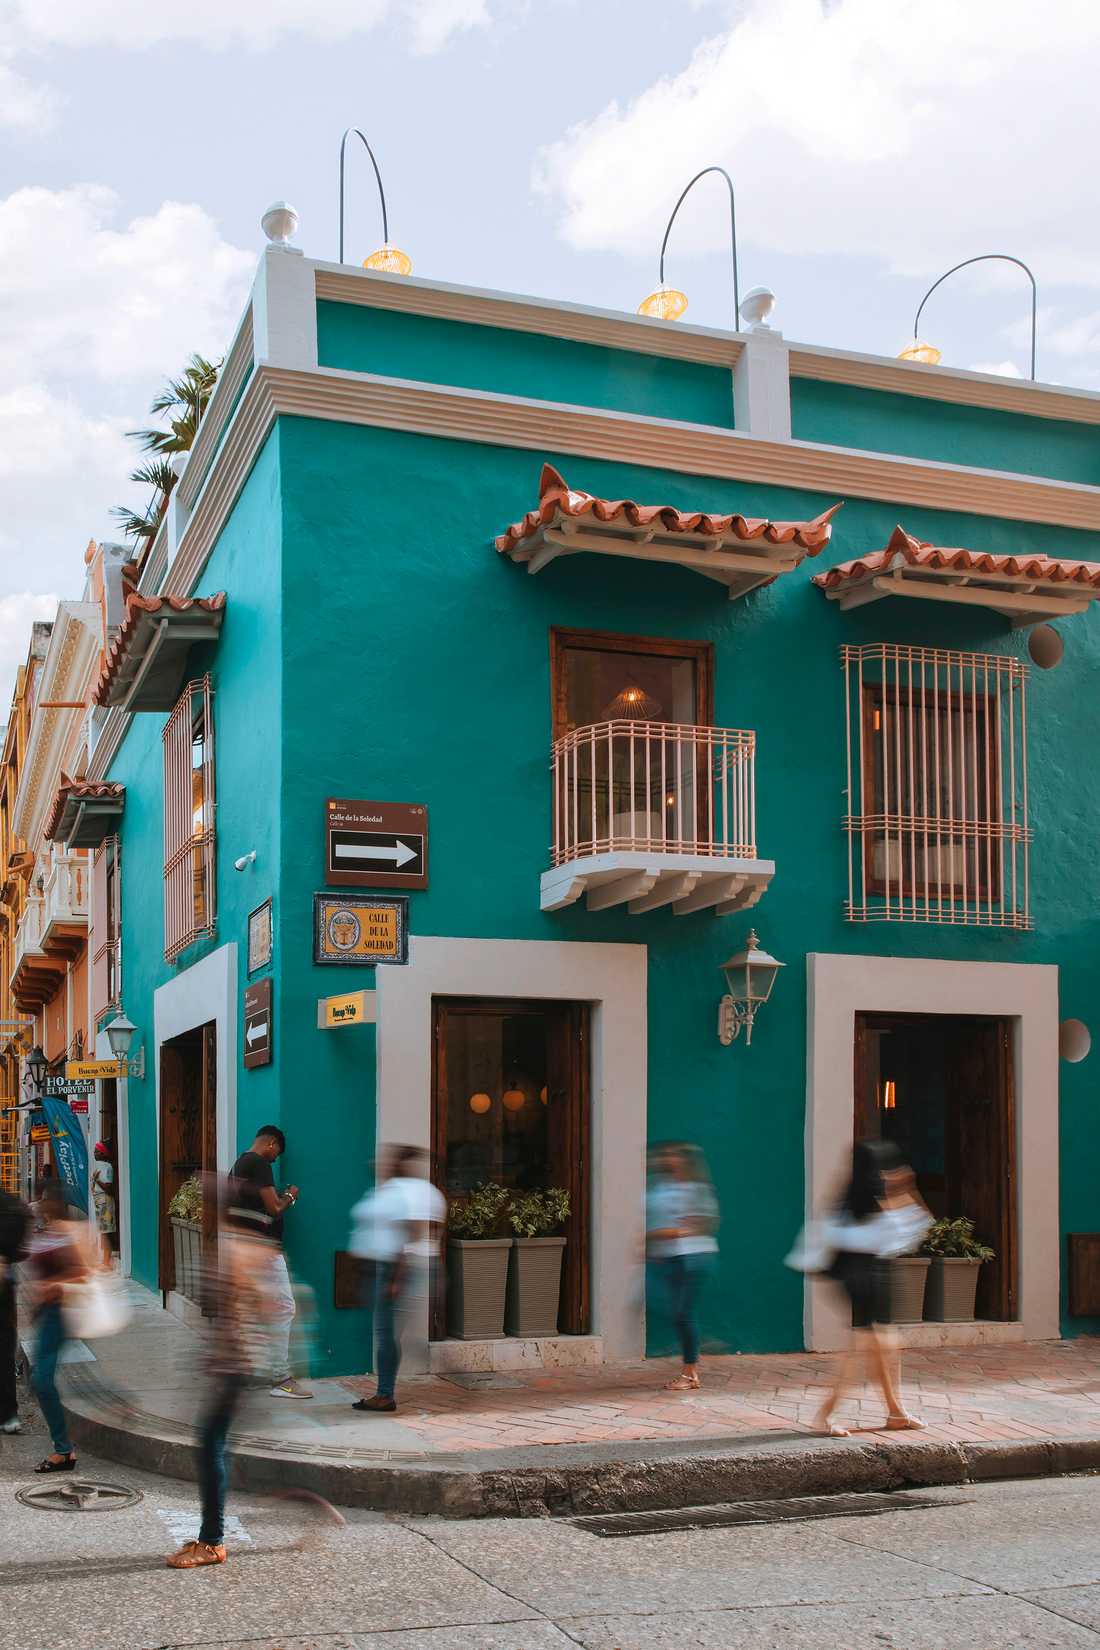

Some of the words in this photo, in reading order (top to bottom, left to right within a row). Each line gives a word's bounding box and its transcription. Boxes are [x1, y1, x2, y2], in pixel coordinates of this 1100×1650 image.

[368, 913, 389, 923] CALLE
[370, 926, 379, 936] DE
[380, 927, 389, 937] LA
[363, 940, 394, 950] SOLEDAD
[78, 1067, 98, 1075] Buena
[99, 1065, 116, 1074] Vida
[47, 1087, 57, 1095] EL
[58, 1085, 96, 1095] PORVENIR
